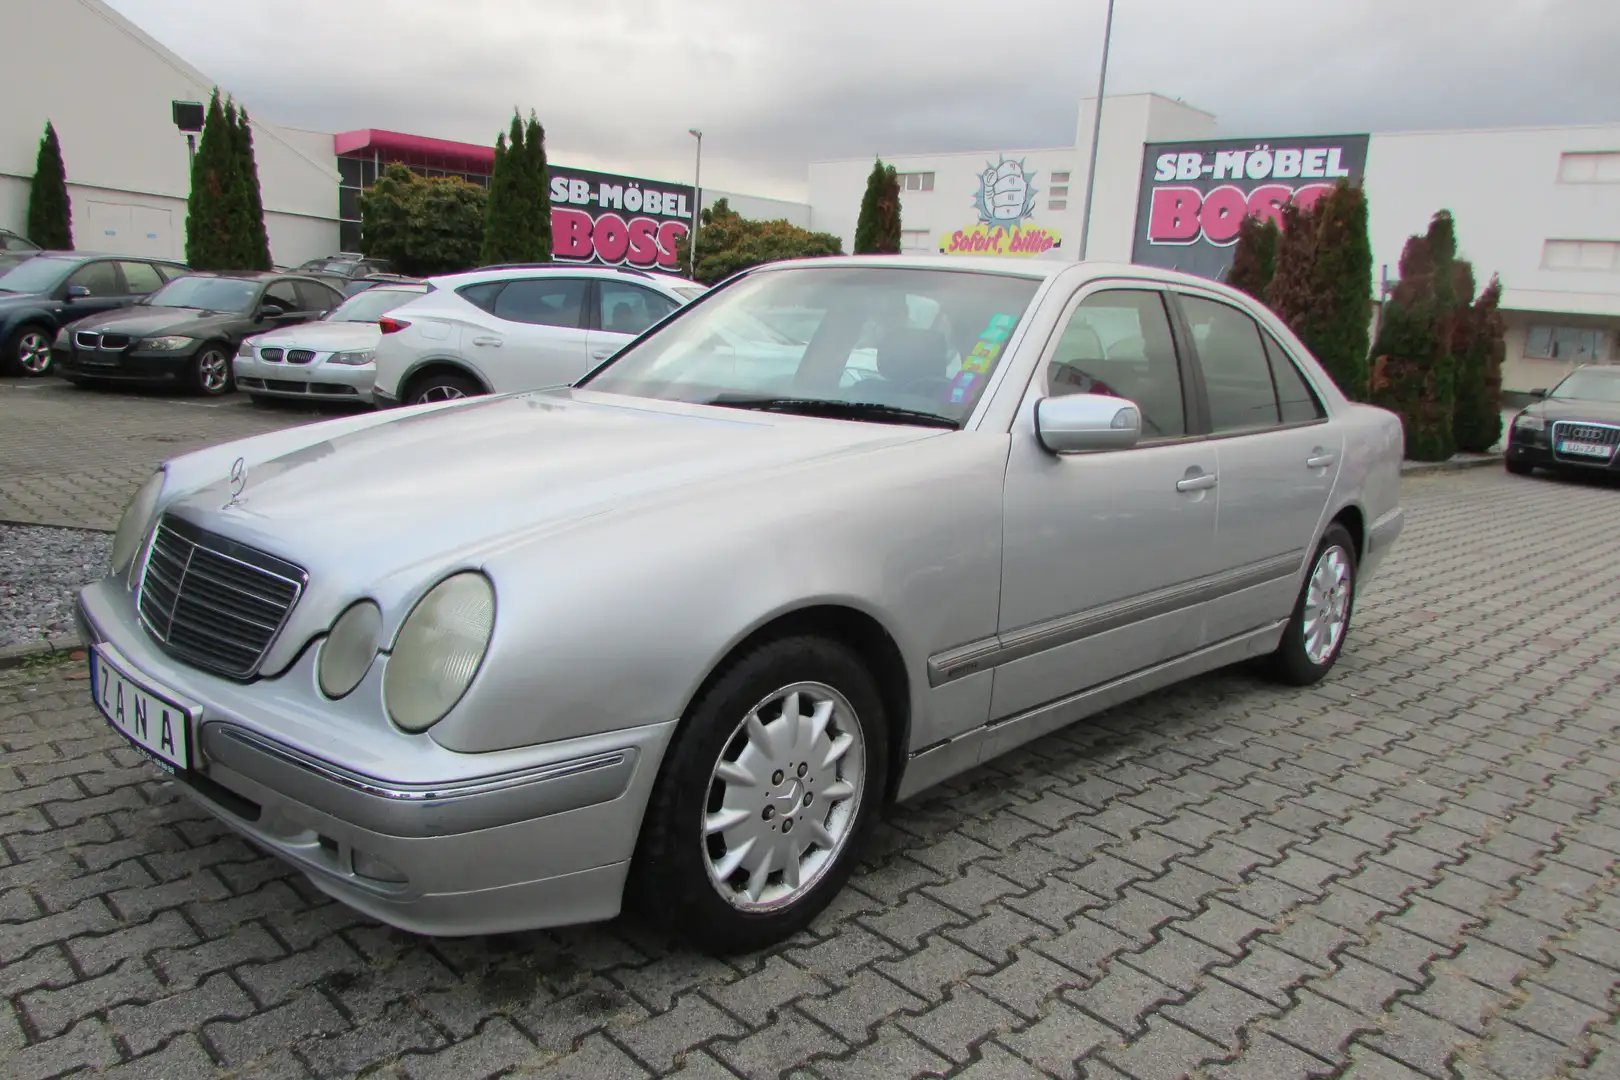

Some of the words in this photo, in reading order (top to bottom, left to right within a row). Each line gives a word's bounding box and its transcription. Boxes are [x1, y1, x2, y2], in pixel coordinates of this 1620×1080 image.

[1154, 144, 1349, 181] SB-MÖBEL
[550, 176, 692, 218] SB-MÖBEL
[551, 207, 689, 271] BOSS
[102, 666, 175, 755] ZANA
